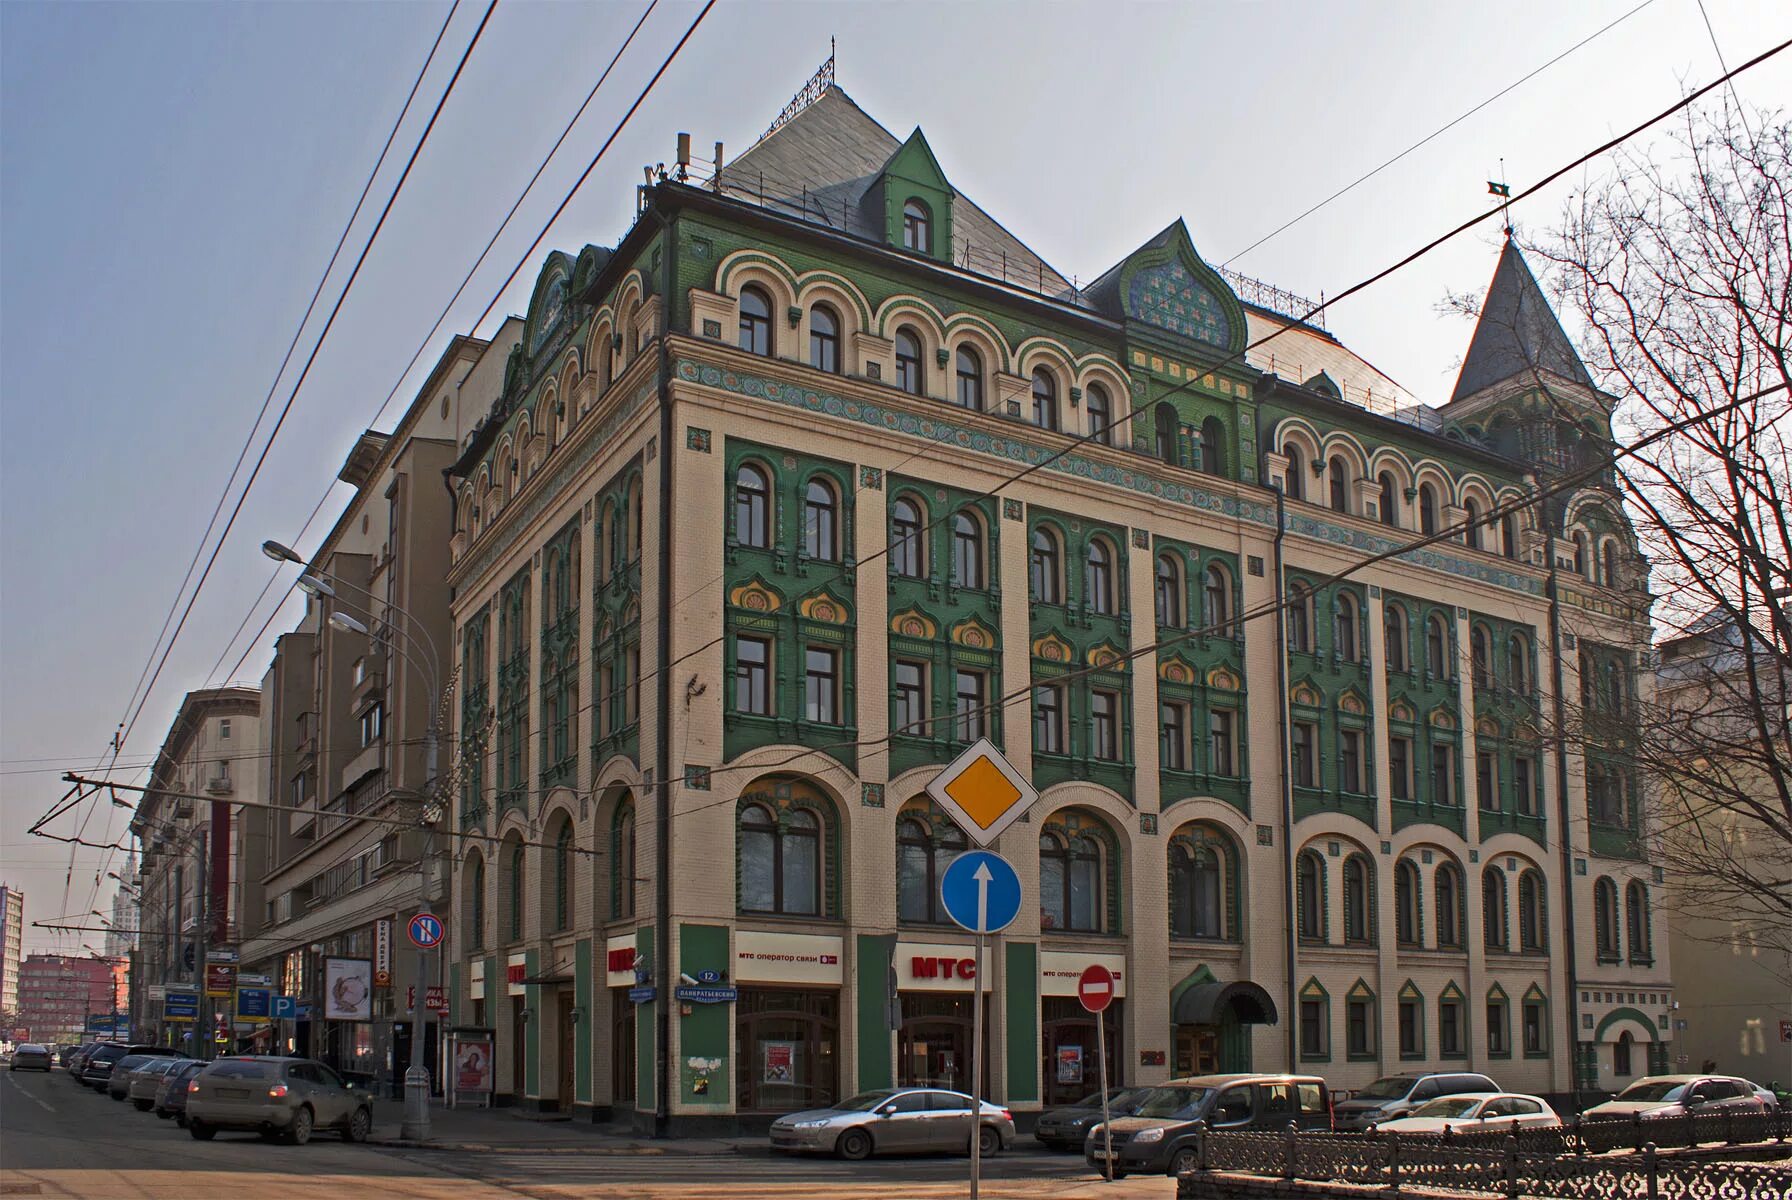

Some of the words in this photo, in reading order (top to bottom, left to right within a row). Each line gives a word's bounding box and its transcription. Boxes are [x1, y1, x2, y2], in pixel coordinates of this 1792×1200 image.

[757, 953, 795, 963] оператор
[797, 955, 818, 963] связи
[911, 957, 976, 980] МТС
[704, 972, 714, 980] 12
